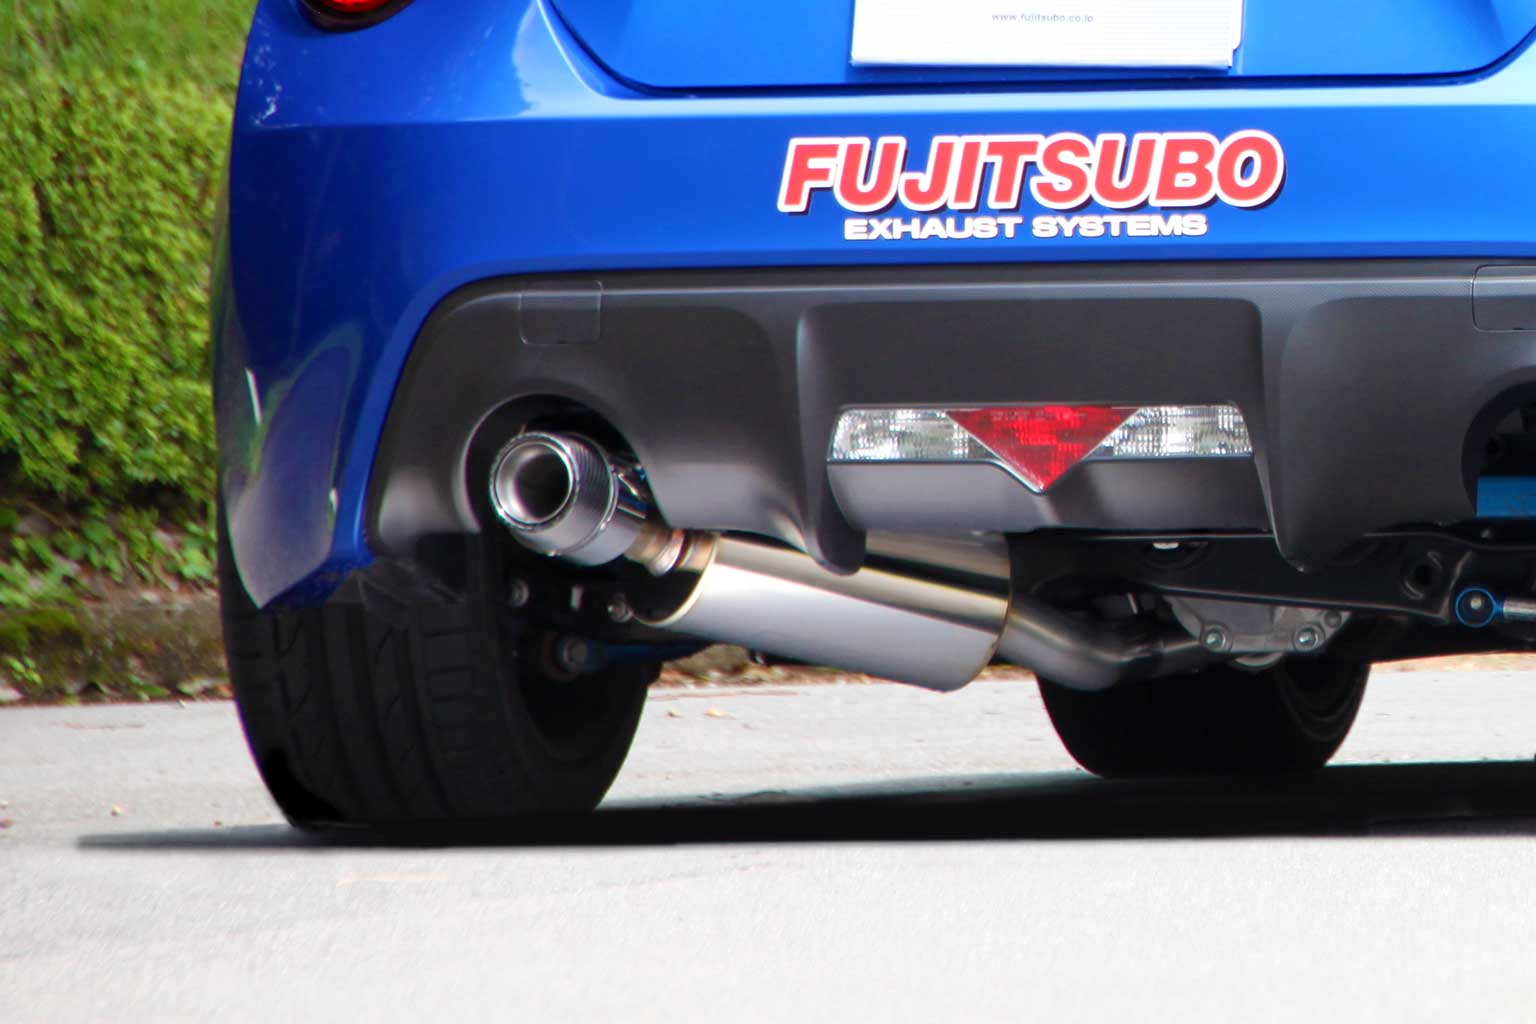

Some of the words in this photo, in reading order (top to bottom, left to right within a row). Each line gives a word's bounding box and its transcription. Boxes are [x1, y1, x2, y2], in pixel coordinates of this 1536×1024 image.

[777, 129, 1285, 212] FUJITSUBO
[844, 217, 1022, 240] EXHAUST
[1032, 214, 1207, 237] SYSTEMS
